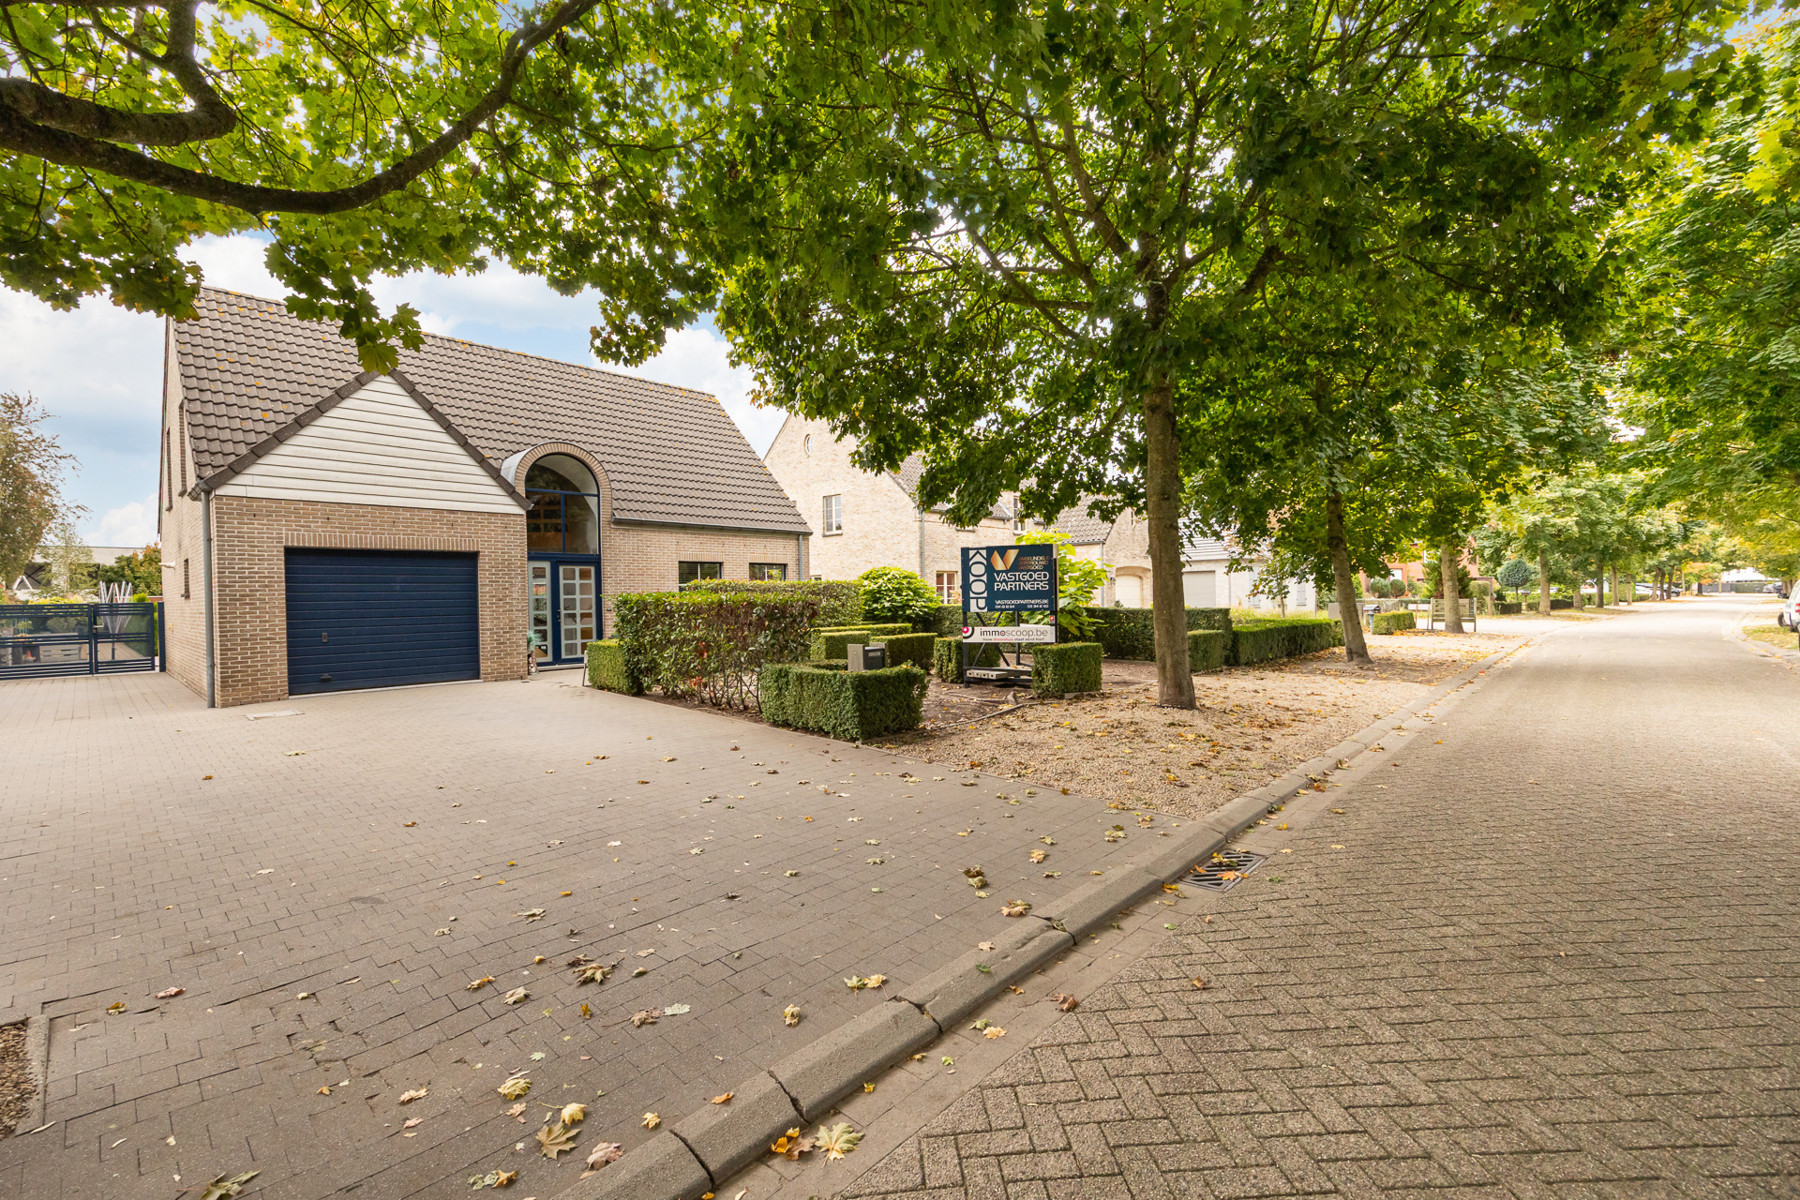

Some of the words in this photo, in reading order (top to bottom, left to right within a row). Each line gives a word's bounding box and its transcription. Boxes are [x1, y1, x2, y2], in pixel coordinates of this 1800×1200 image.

[969, 548, 987, 611] KOOP
[994, 571, 1049, 581] VASTGOED
[994, 581, 1049, 591] PARTNERS
[980, 628, 1048, 637] immoscoop.be
